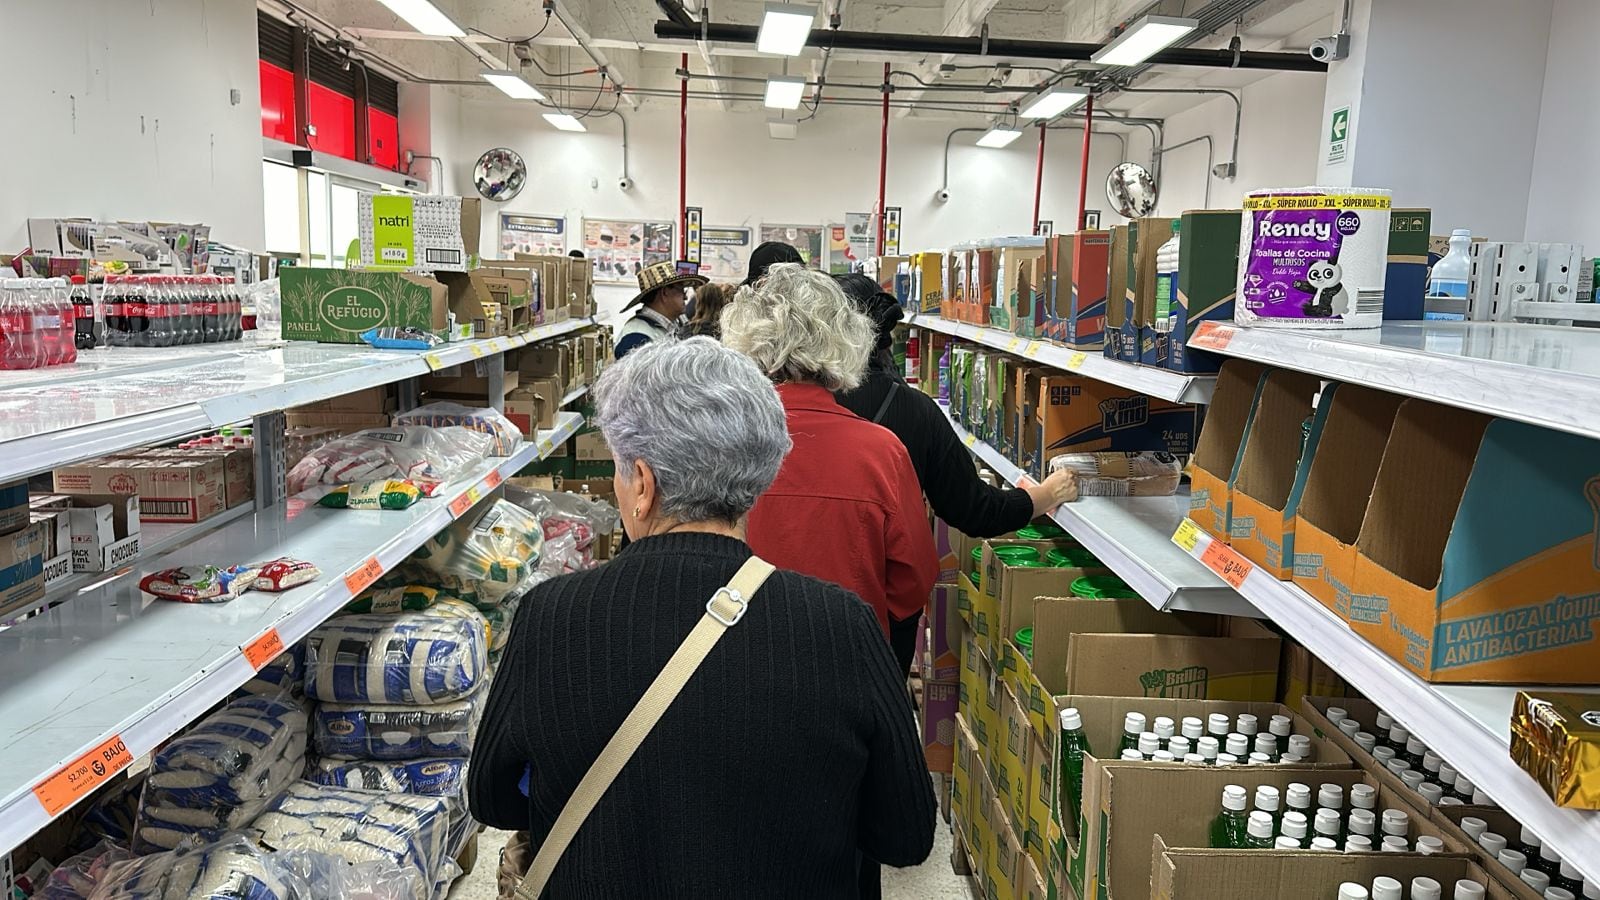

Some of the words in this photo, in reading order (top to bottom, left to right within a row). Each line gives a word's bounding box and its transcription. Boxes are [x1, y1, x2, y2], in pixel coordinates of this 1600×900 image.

[1277, 199, 1296, 208] SÚPER
[1298, 199, 1317, 207] ROLLO
[1324, 199, 1336, 207] XXL
[1343, 197, 1361, 207] SÚPER
[379, 216, 409, 227] natri
[1338, 217, 1359, 226] 660
[508, 224, 558, 233] EXTRAORDINARIOS
[1259, 219, 1331, 241] Rendy
[1256, 249, 1282, 258] Toallas
[1284, 249, 1296, 258] de
[1298, 249, 1330, 258] Cocina
[347, 295, 361, 306] EL
[327, 305, 381, 320] REFUGIO
[287, 322, 321, 332] PANELA
[1162, 430, 1173, 440] 24
[111, 539, 139, 564] CHOCOLATE
[44, 558, 68, 582] OCOLATE
[1233, 563, 1249, 578] BAJÓ
[1446, 606, 1539, 644] LAVALOZA
[1443, 620, 1591, 666] ANTIBACTERIAL
[103, 738, 126, 762] BAJÓ
